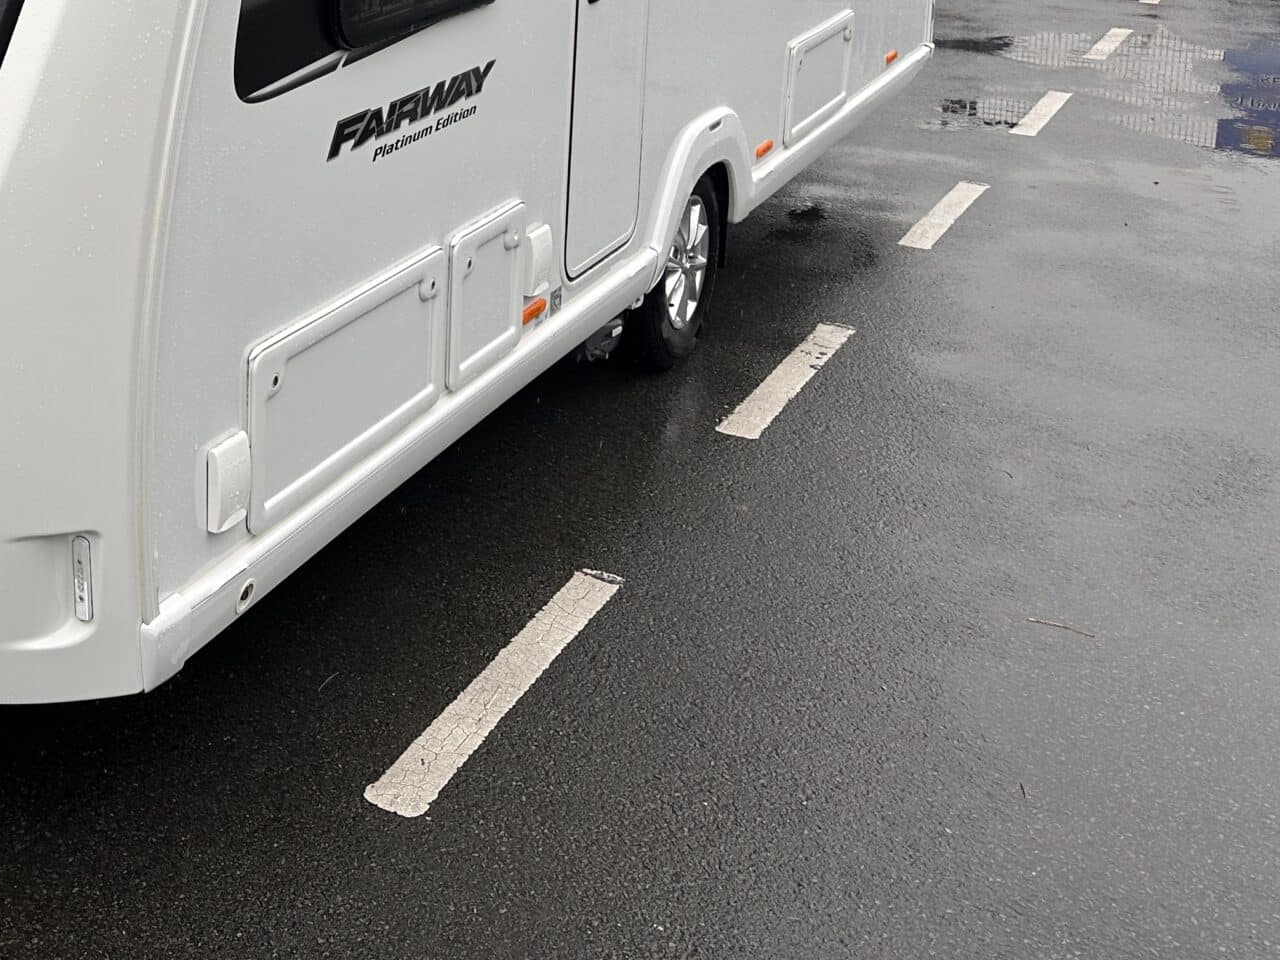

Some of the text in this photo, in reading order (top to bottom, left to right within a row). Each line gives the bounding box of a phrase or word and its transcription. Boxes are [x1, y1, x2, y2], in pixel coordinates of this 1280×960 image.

[326, 59, 496, 162] FAIRWAY
[372, 105, 477, 162] Platinum Edition
